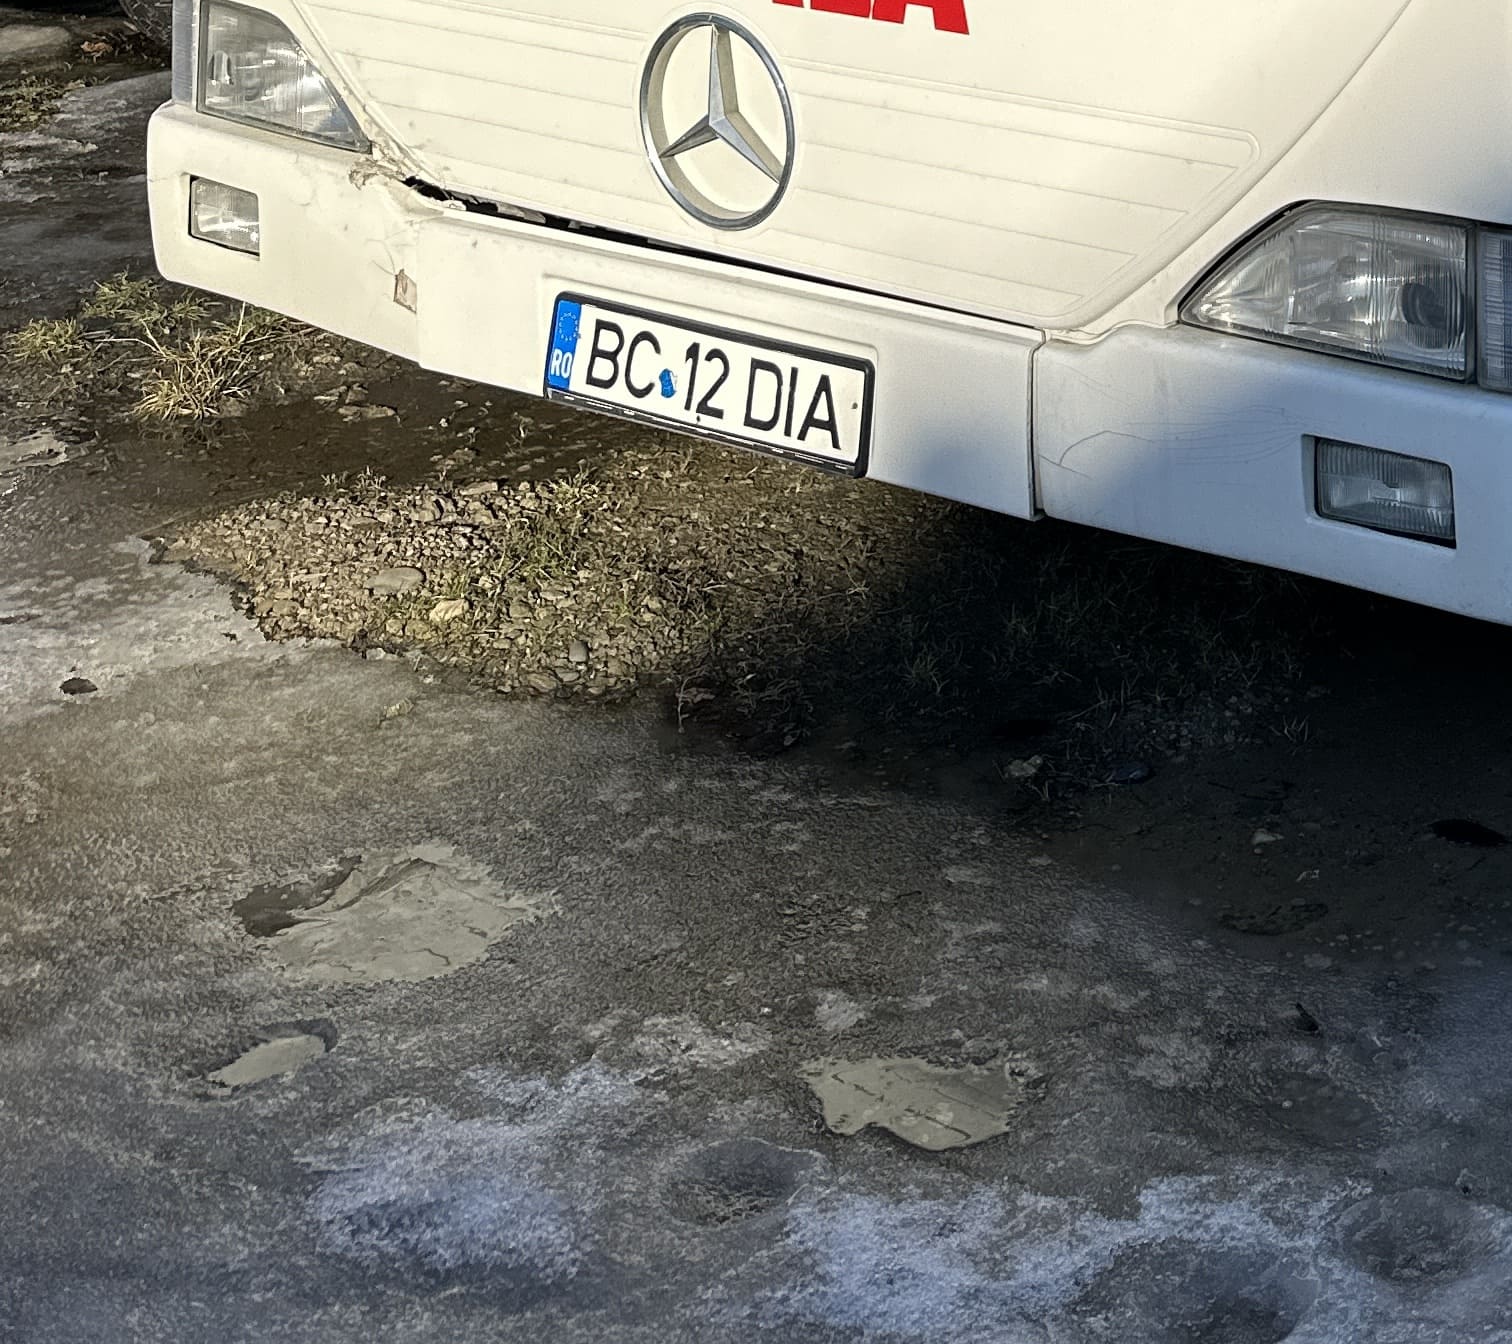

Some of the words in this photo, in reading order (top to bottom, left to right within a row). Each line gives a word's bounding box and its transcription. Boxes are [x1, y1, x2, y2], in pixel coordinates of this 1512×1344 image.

[550, 348, 573, 379] RO
[585, 318, 661, 398] BC
[685, 342, 730, 419] 12
[743, 357, 841, 450] DIA
